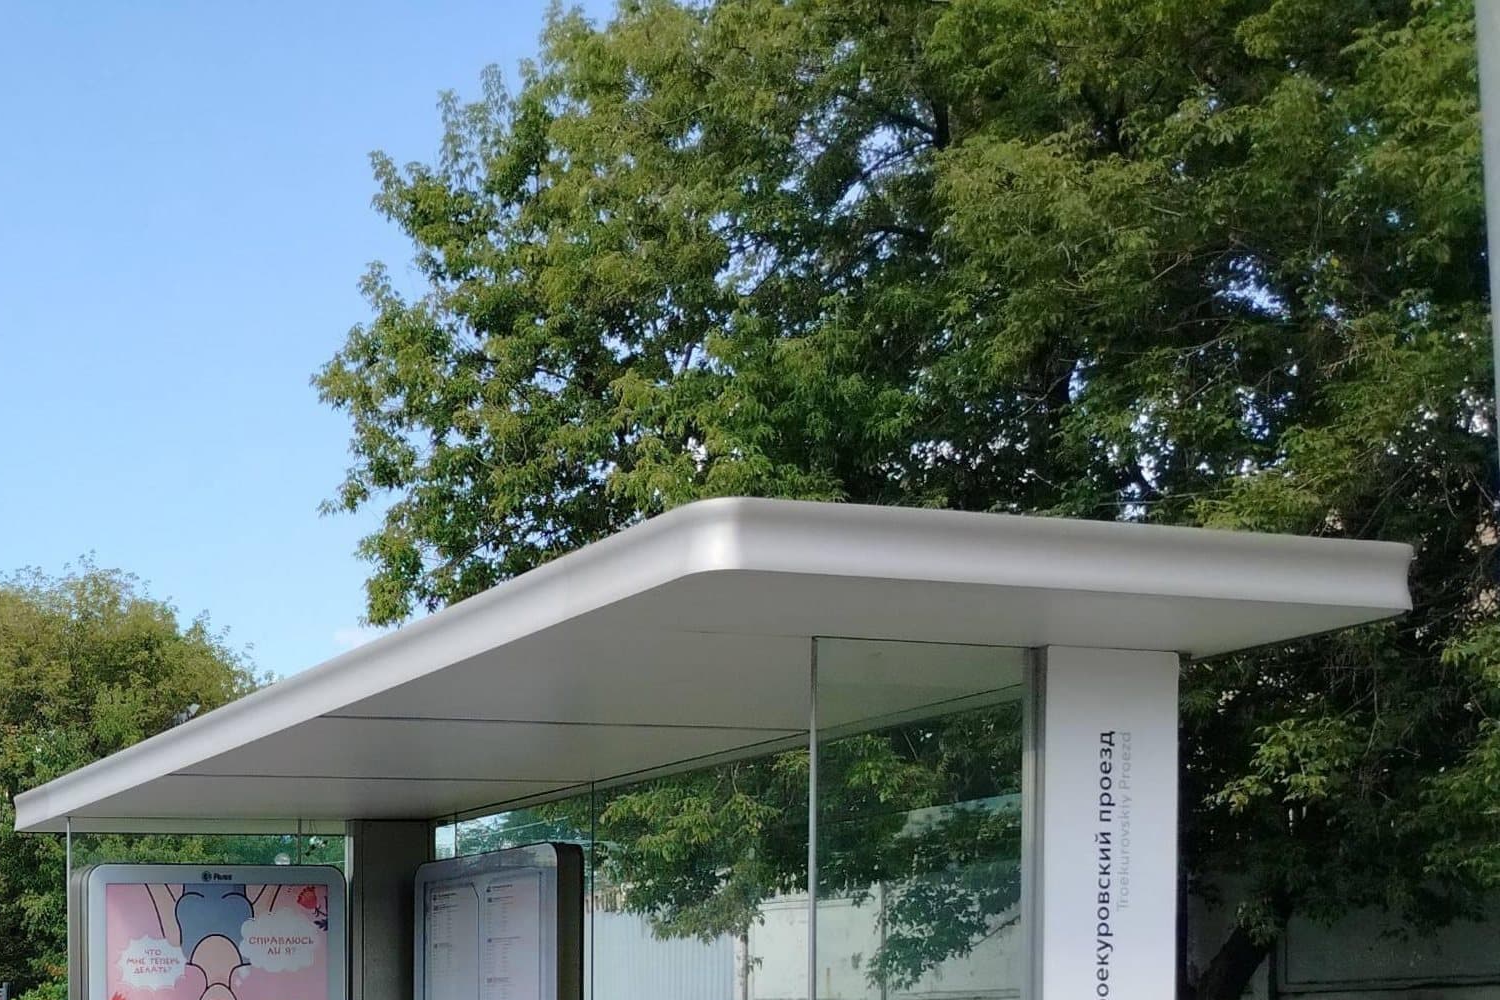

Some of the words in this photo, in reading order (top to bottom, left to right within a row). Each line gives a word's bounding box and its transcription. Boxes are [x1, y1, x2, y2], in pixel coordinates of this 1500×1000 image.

[1099, 730, 1116, 823] проезд
[1118, 731, 1132, 790] Proezd
[1116, 794, 1133, 912] Troekurovskiy
[144, 948, 162, 956] ЧТО
[248, 935, 315, 945] СПРАВЛЮСЬ
